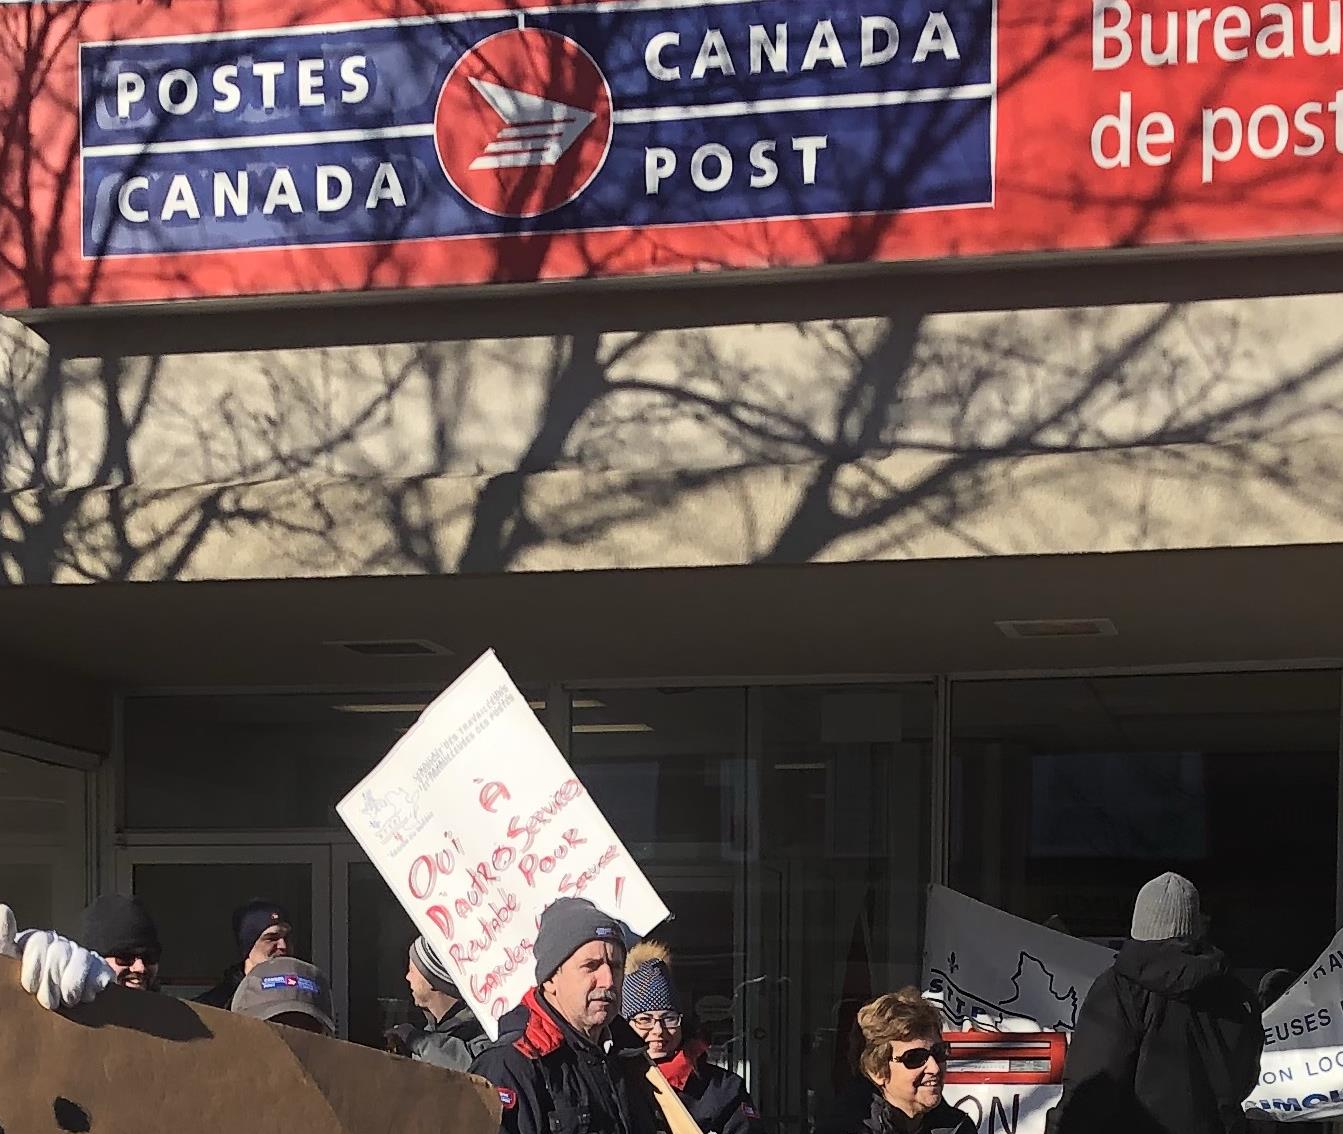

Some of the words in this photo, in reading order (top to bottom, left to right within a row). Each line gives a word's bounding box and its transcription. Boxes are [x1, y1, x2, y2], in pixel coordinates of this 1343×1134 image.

[643, 10, 962, 81] CANADA
[1091, 0, 1342, 71] Bureau
[116, 55, 371, 117] POSTES
[1090, 91, 1174, 169] de
[116, 161, 408, 224] CANADA
[643, 135, 829, 195] POST
[1257, 1067, 1293, 1085] ON
